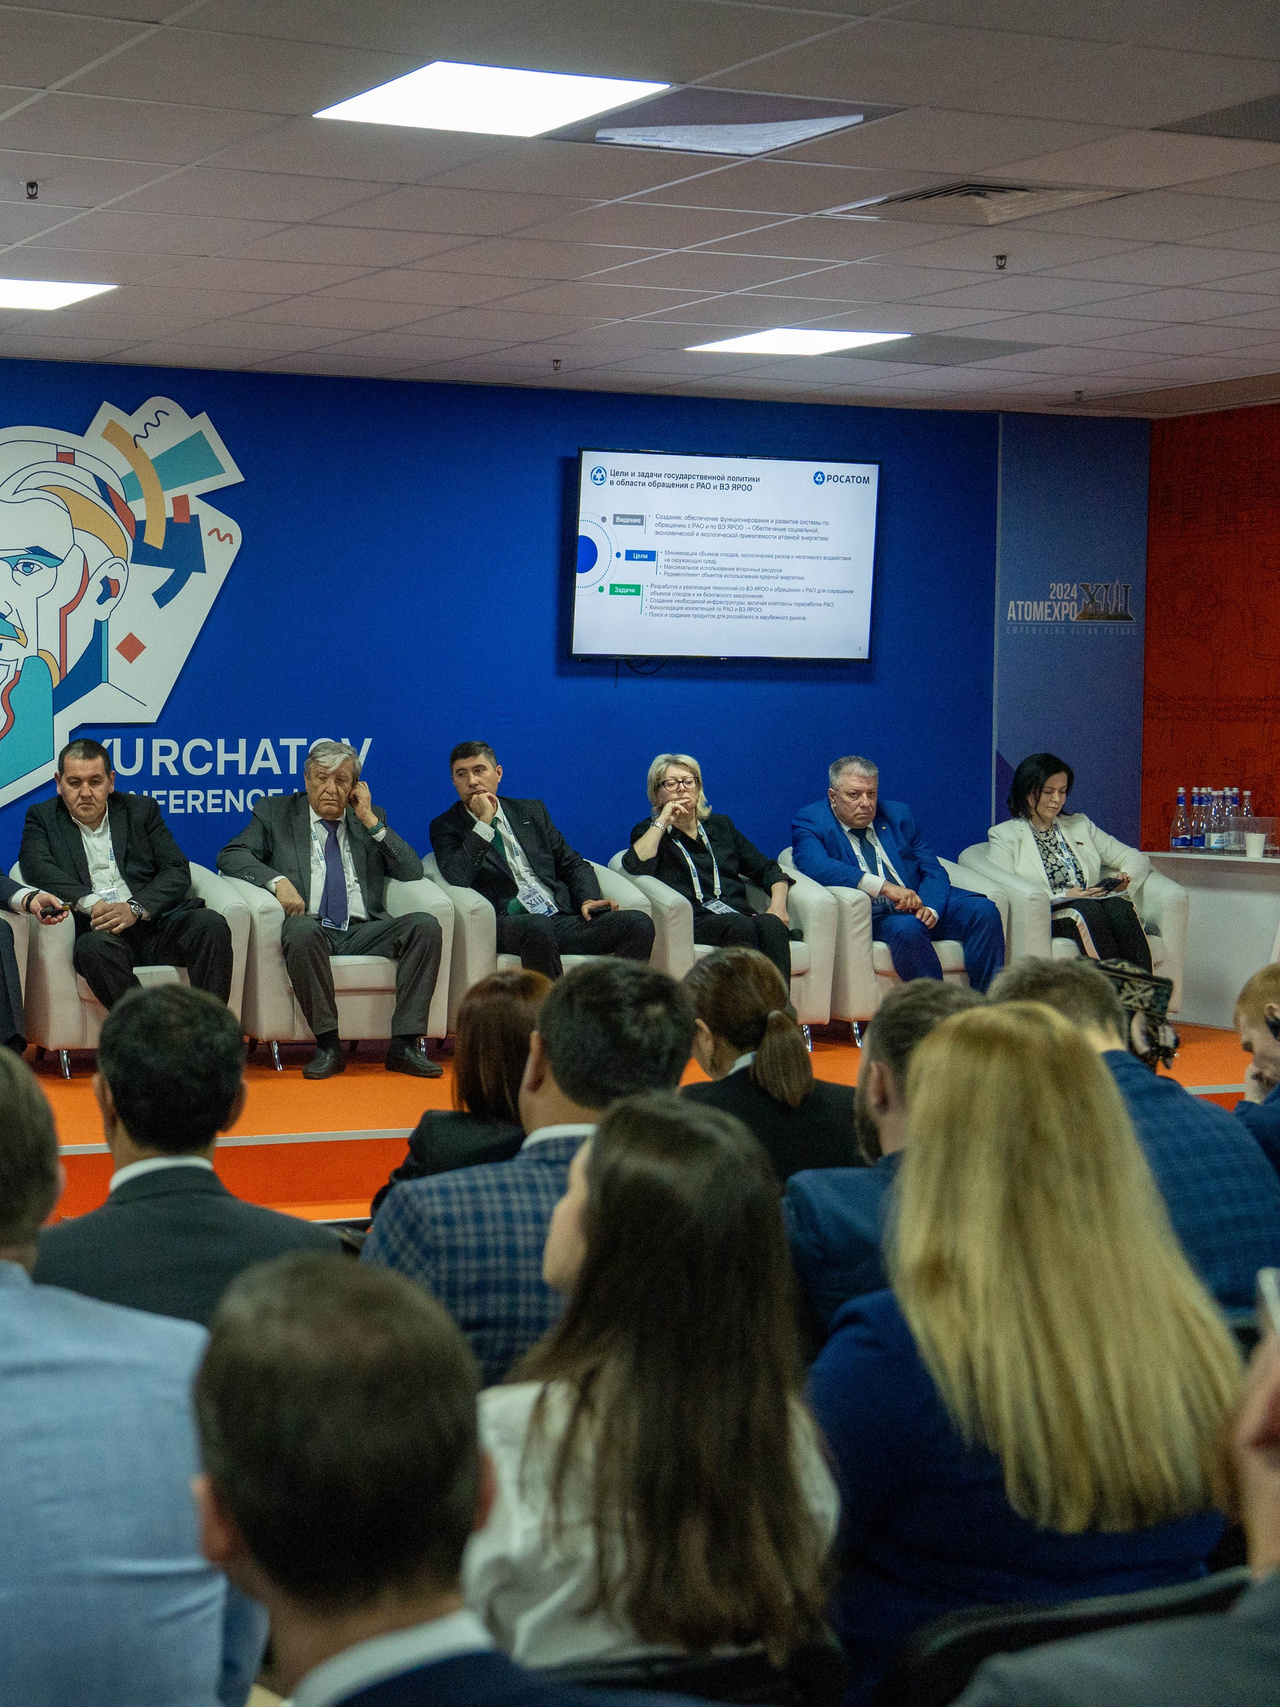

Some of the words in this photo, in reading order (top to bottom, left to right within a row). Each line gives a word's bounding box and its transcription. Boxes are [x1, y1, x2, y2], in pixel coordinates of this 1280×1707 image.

[610, 469, 630, 478] Цели
[637, 472, 663, 480] задачи
[664, 471, 726, 483] государственной
[826, 474, 870, 485] РОСАТОМ
[616, 478, 647, 487] области
[648, 479, 689, 490] обращения
[731, 483, 753, 491] ЯРОО
[633, 552, 648, 560] Цели
[614, 586, 636, 595] Задачи
[1049, 582, 1078, 600] 2024
[1006, 600, 1078, 621] ATOMEXPO
[101, 738, 373, 776] URCHATV
